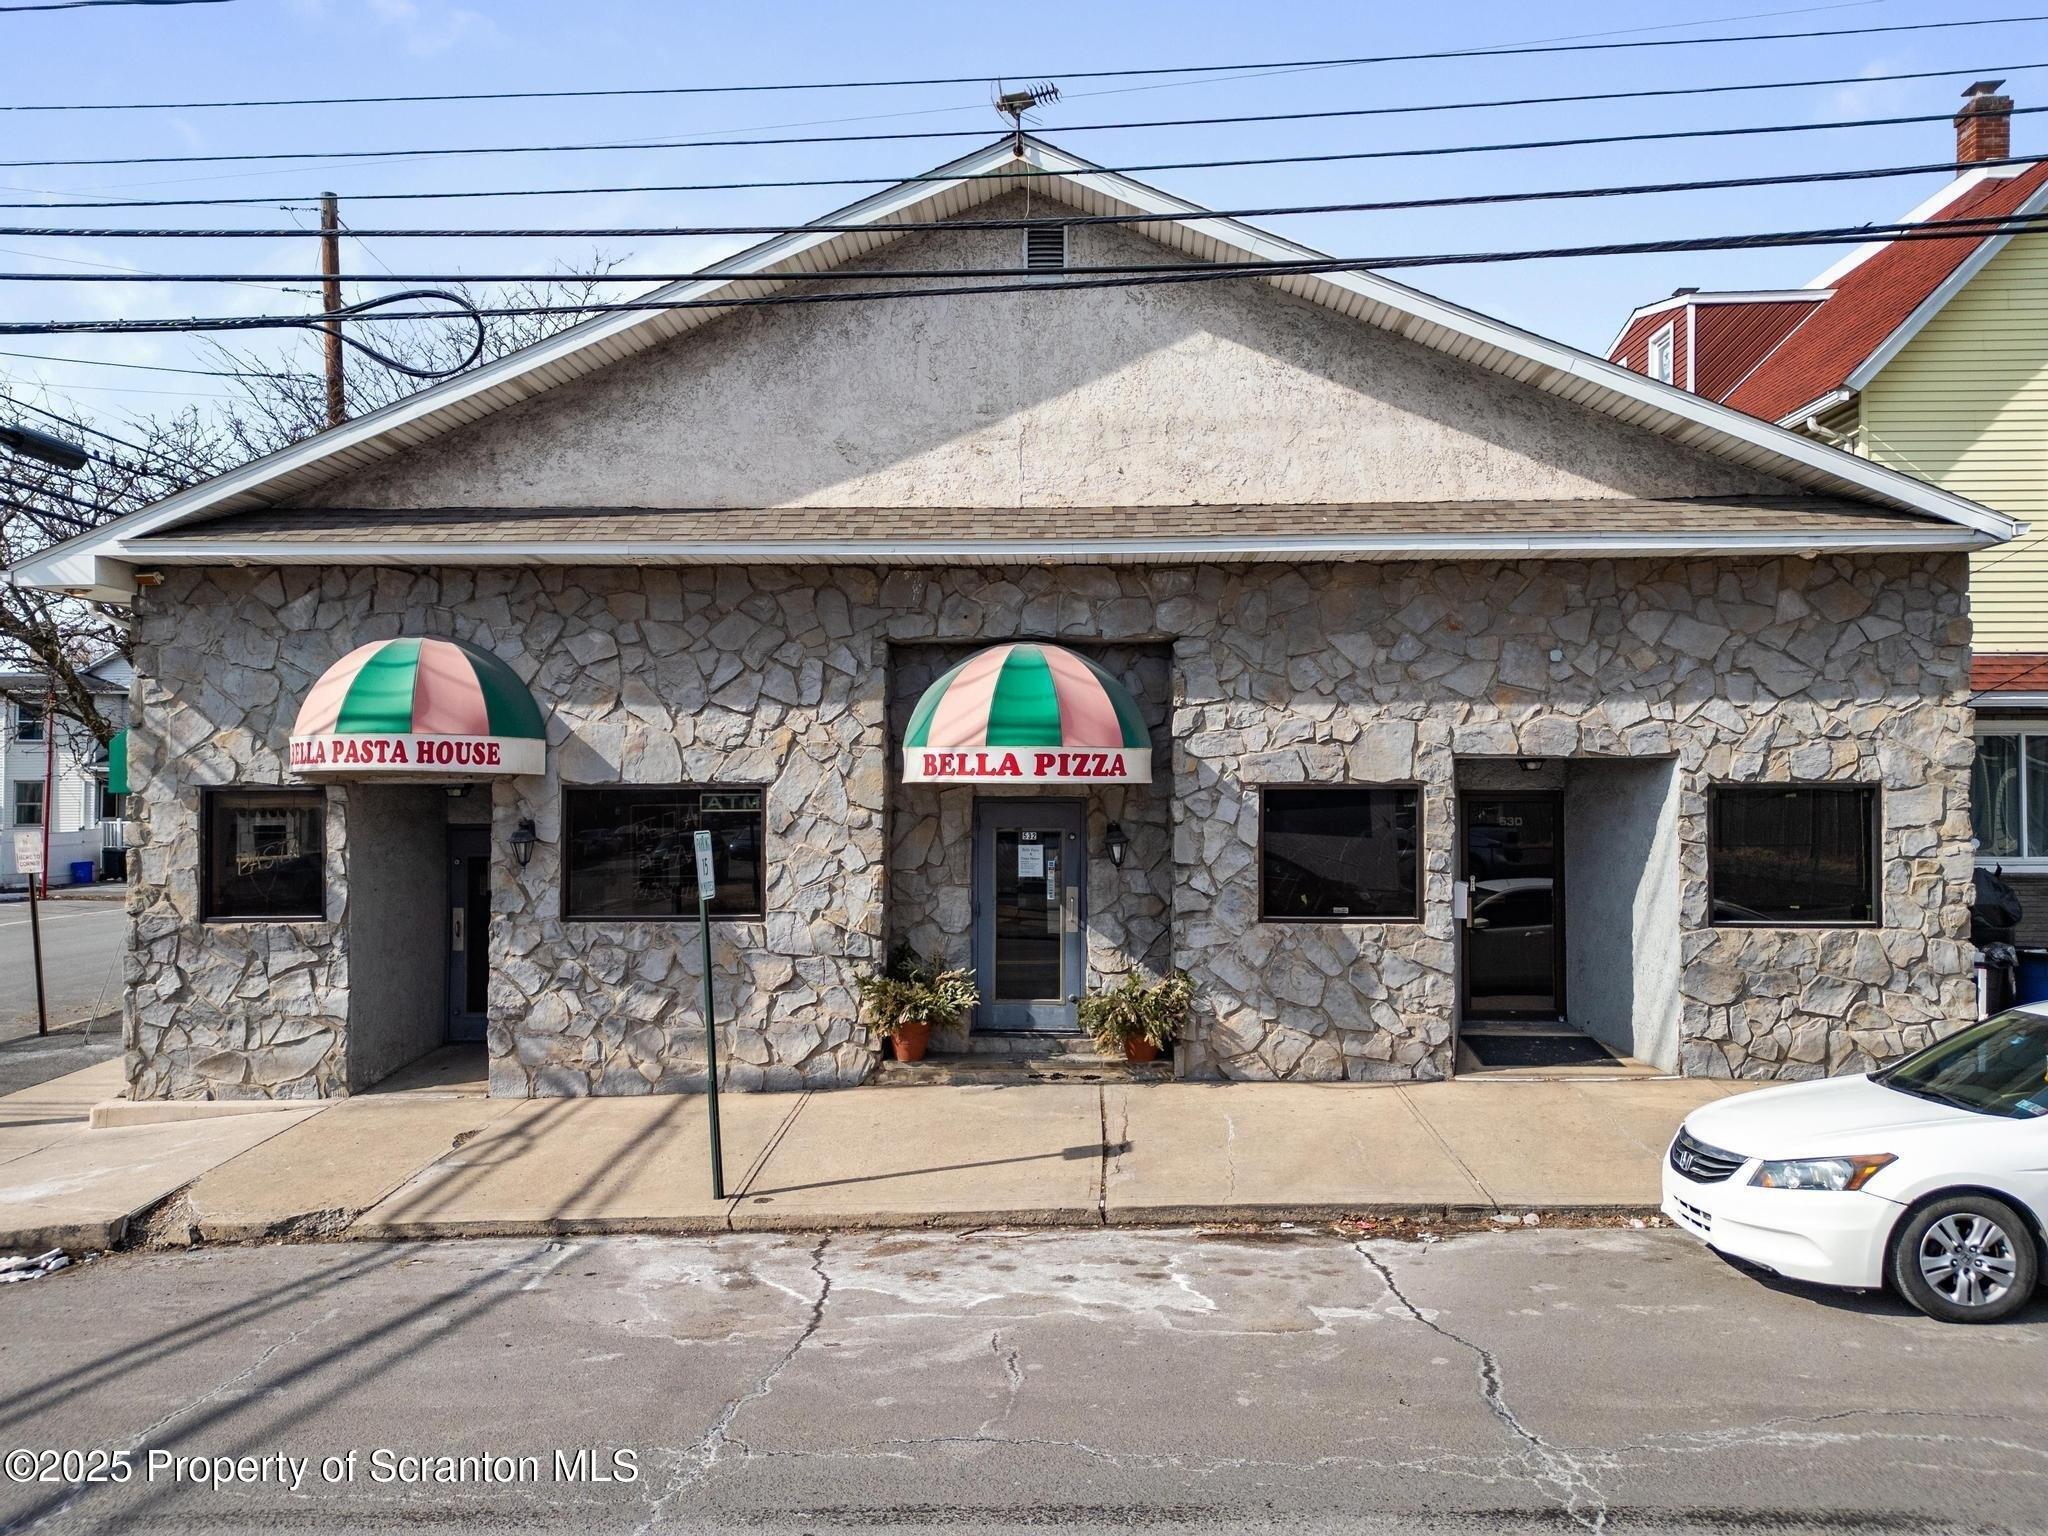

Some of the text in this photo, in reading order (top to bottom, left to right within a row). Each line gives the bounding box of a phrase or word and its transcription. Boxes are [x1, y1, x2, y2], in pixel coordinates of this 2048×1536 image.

[331, 740, 409, 764] PASTA
[416, 741, 501, 766] HOUSE
[923, 753, 1128, 777] BELLA PIZZA
[707, 797, 760, 810] ATM
[1022, 832, 1037, 840] 532
[702, 857, 709, 876] 15
